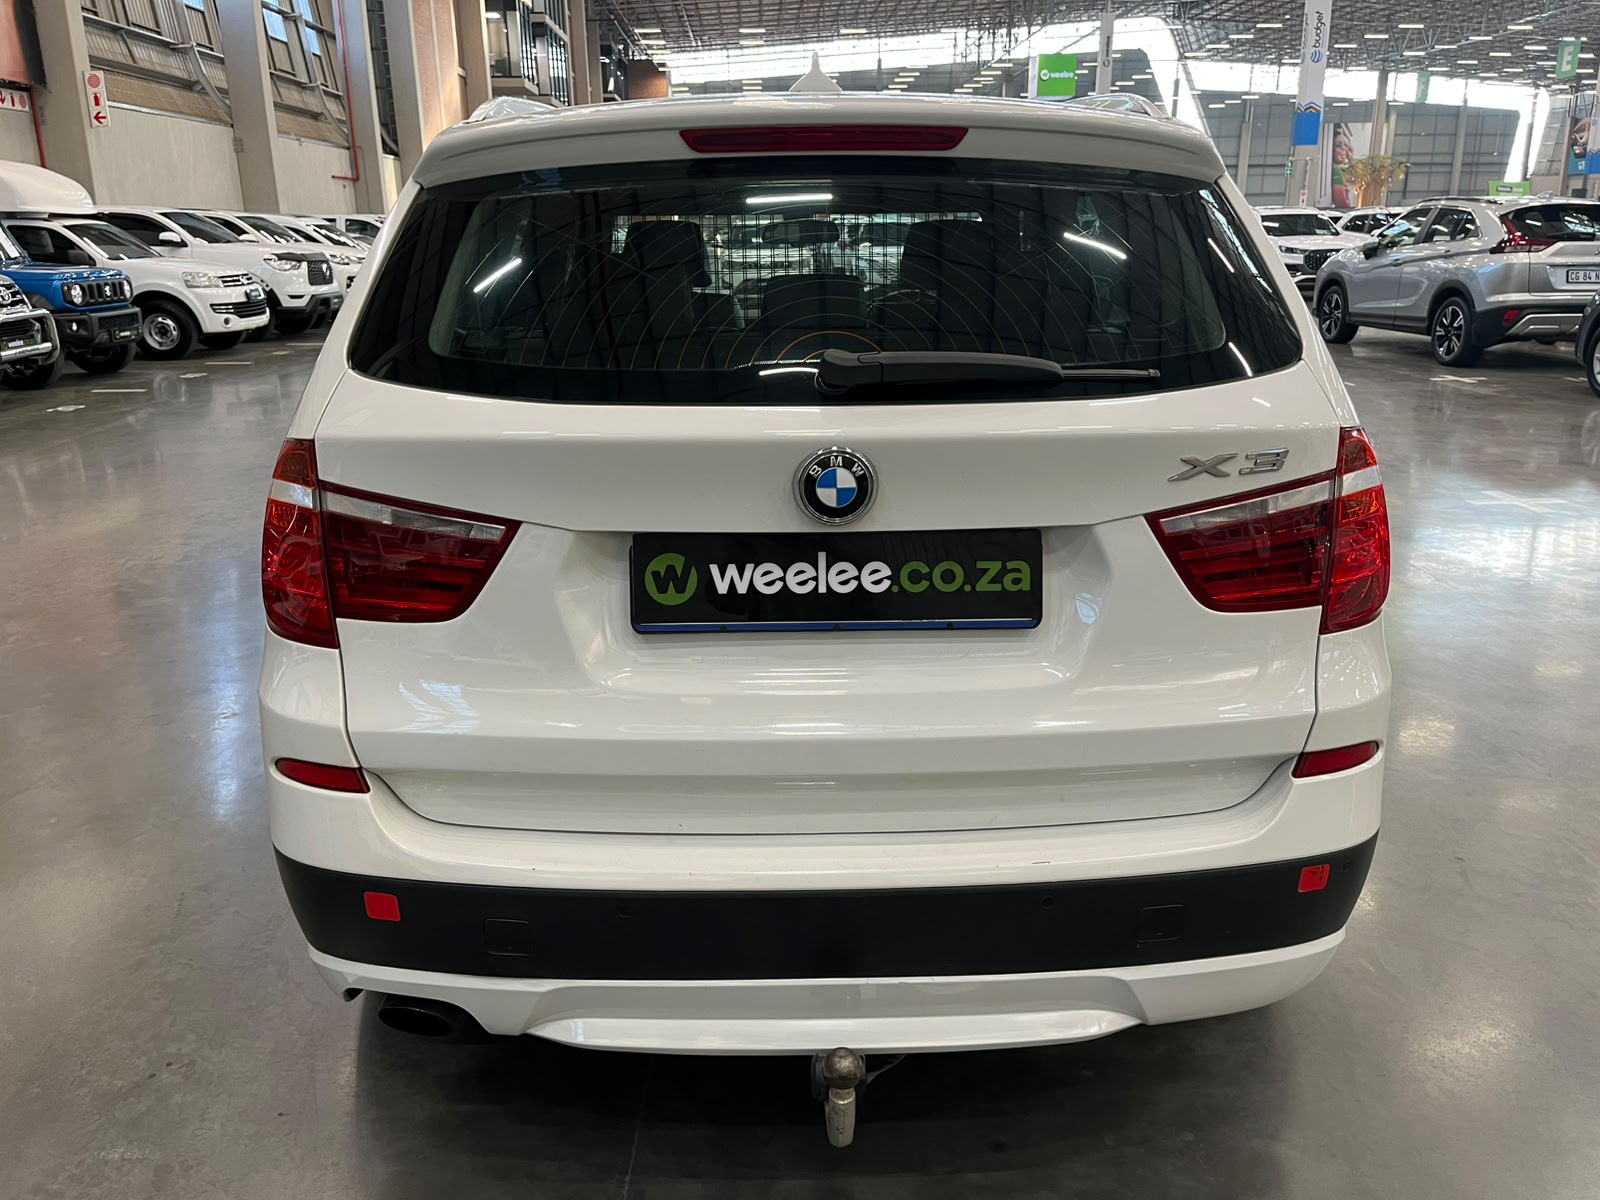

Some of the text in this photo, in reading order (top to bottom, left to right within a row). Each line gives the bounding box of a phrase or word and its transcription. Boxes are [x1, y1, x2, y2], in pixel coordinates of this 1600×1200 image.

[1312, 10, 1326, 48] budget
[1560, 45, 1574, 72] E
[1570, 272, 1580, 280] CG
[1583, 272, 1592, 280] 84
[809, 456, 865, 478] BMW
[1167, 447, 1289, 482] X3
[708, 551, 1032, 595] weelee.co.za
